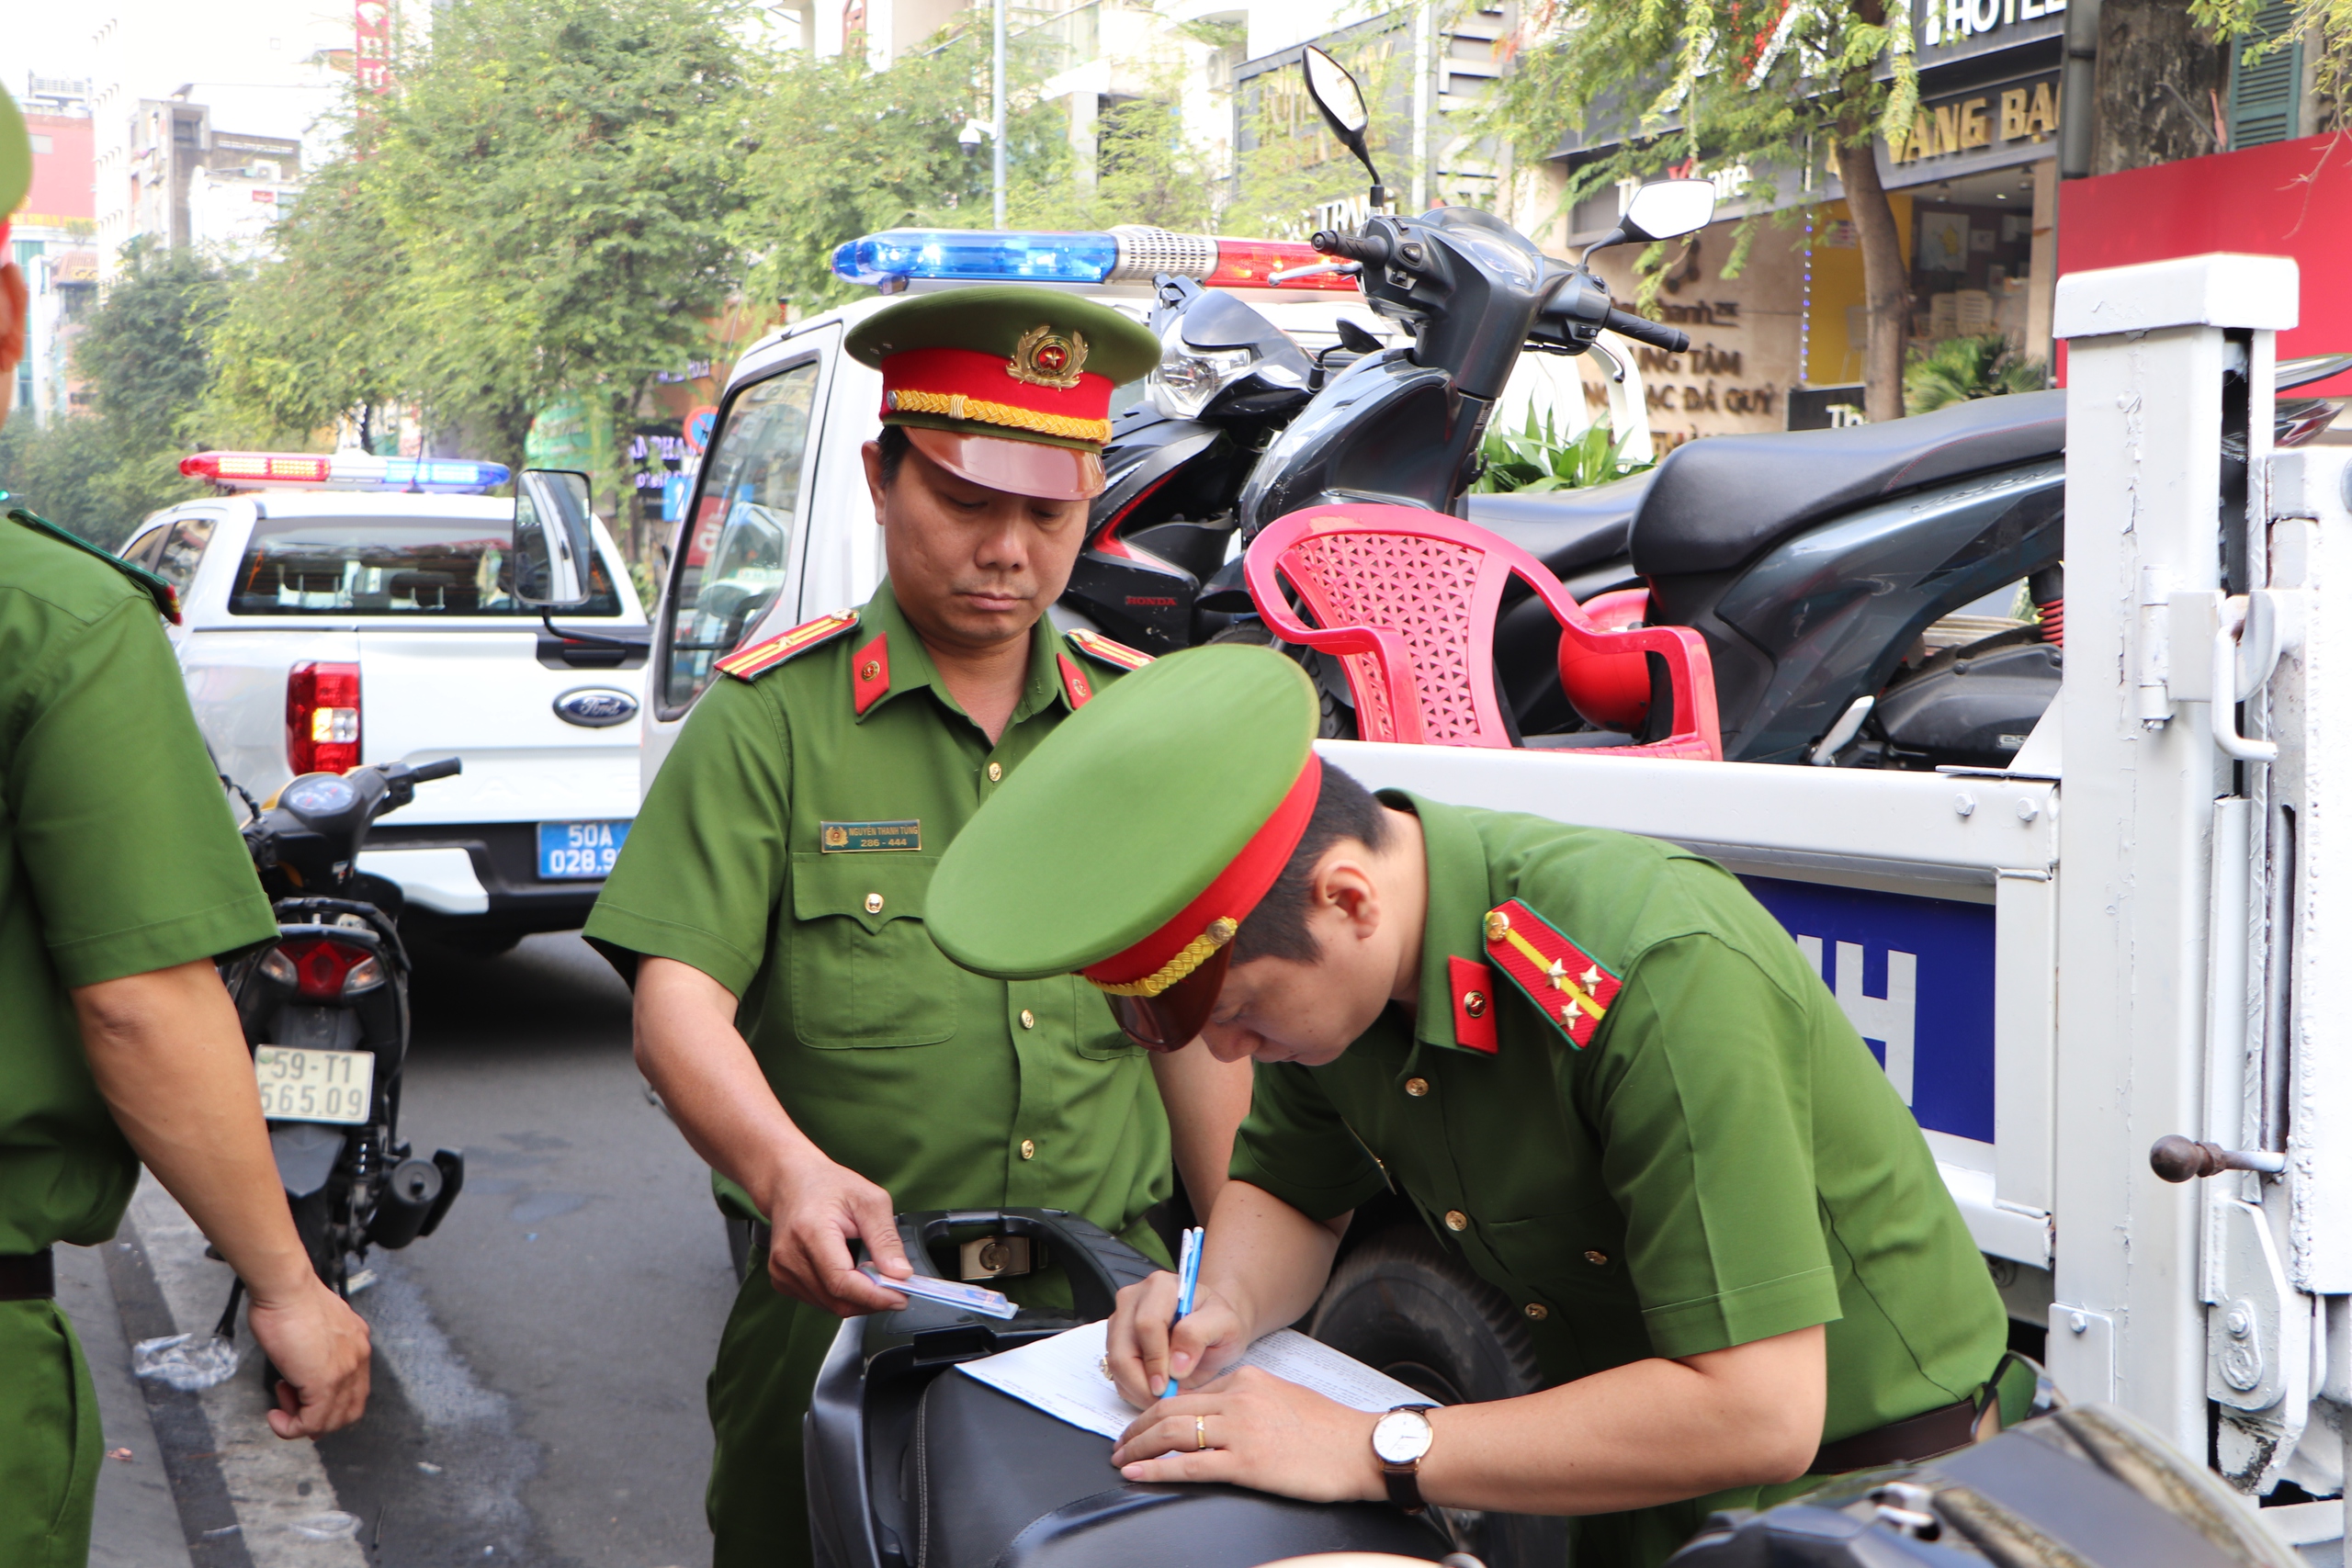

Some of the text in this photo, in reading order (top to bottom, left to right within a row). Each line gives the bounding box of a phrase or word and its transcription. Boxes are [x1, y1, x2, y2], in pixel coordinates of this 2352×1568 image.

[2000, 82, 2062, 143] BẠ
[1125, 595, 1178, 606] HONDA
[581, 696, 621, 716] Ford
[568, 823, 614, 848] 50A
[878, 827, 899, 835] THANH
[549, 847, 622, 873] 028.9
[259, 1081, 364, 1118] 565.09
